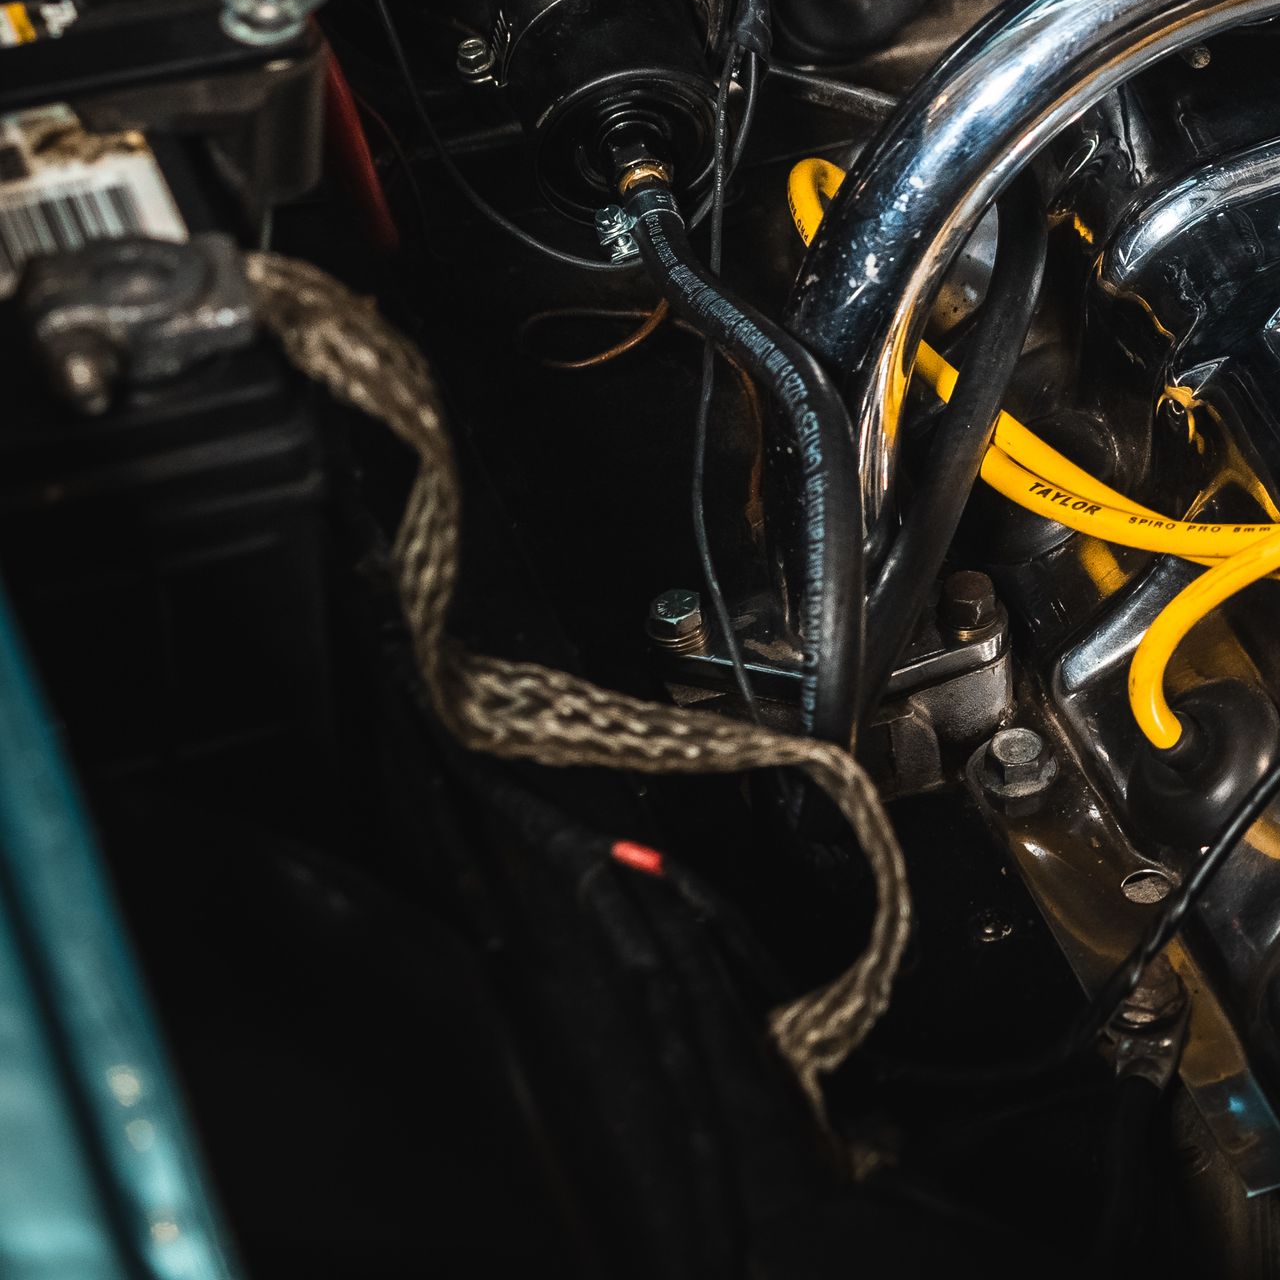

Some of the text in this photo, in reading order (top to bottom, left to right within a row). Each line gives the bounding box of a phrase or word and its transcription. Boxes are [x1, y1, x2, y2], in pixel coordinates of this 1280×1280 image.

[1028, 482, 1101, 517] TAYLOR
[1128, 516, 1176, 530] SPIRO
[1186, 525, 1222, 534] PRO
